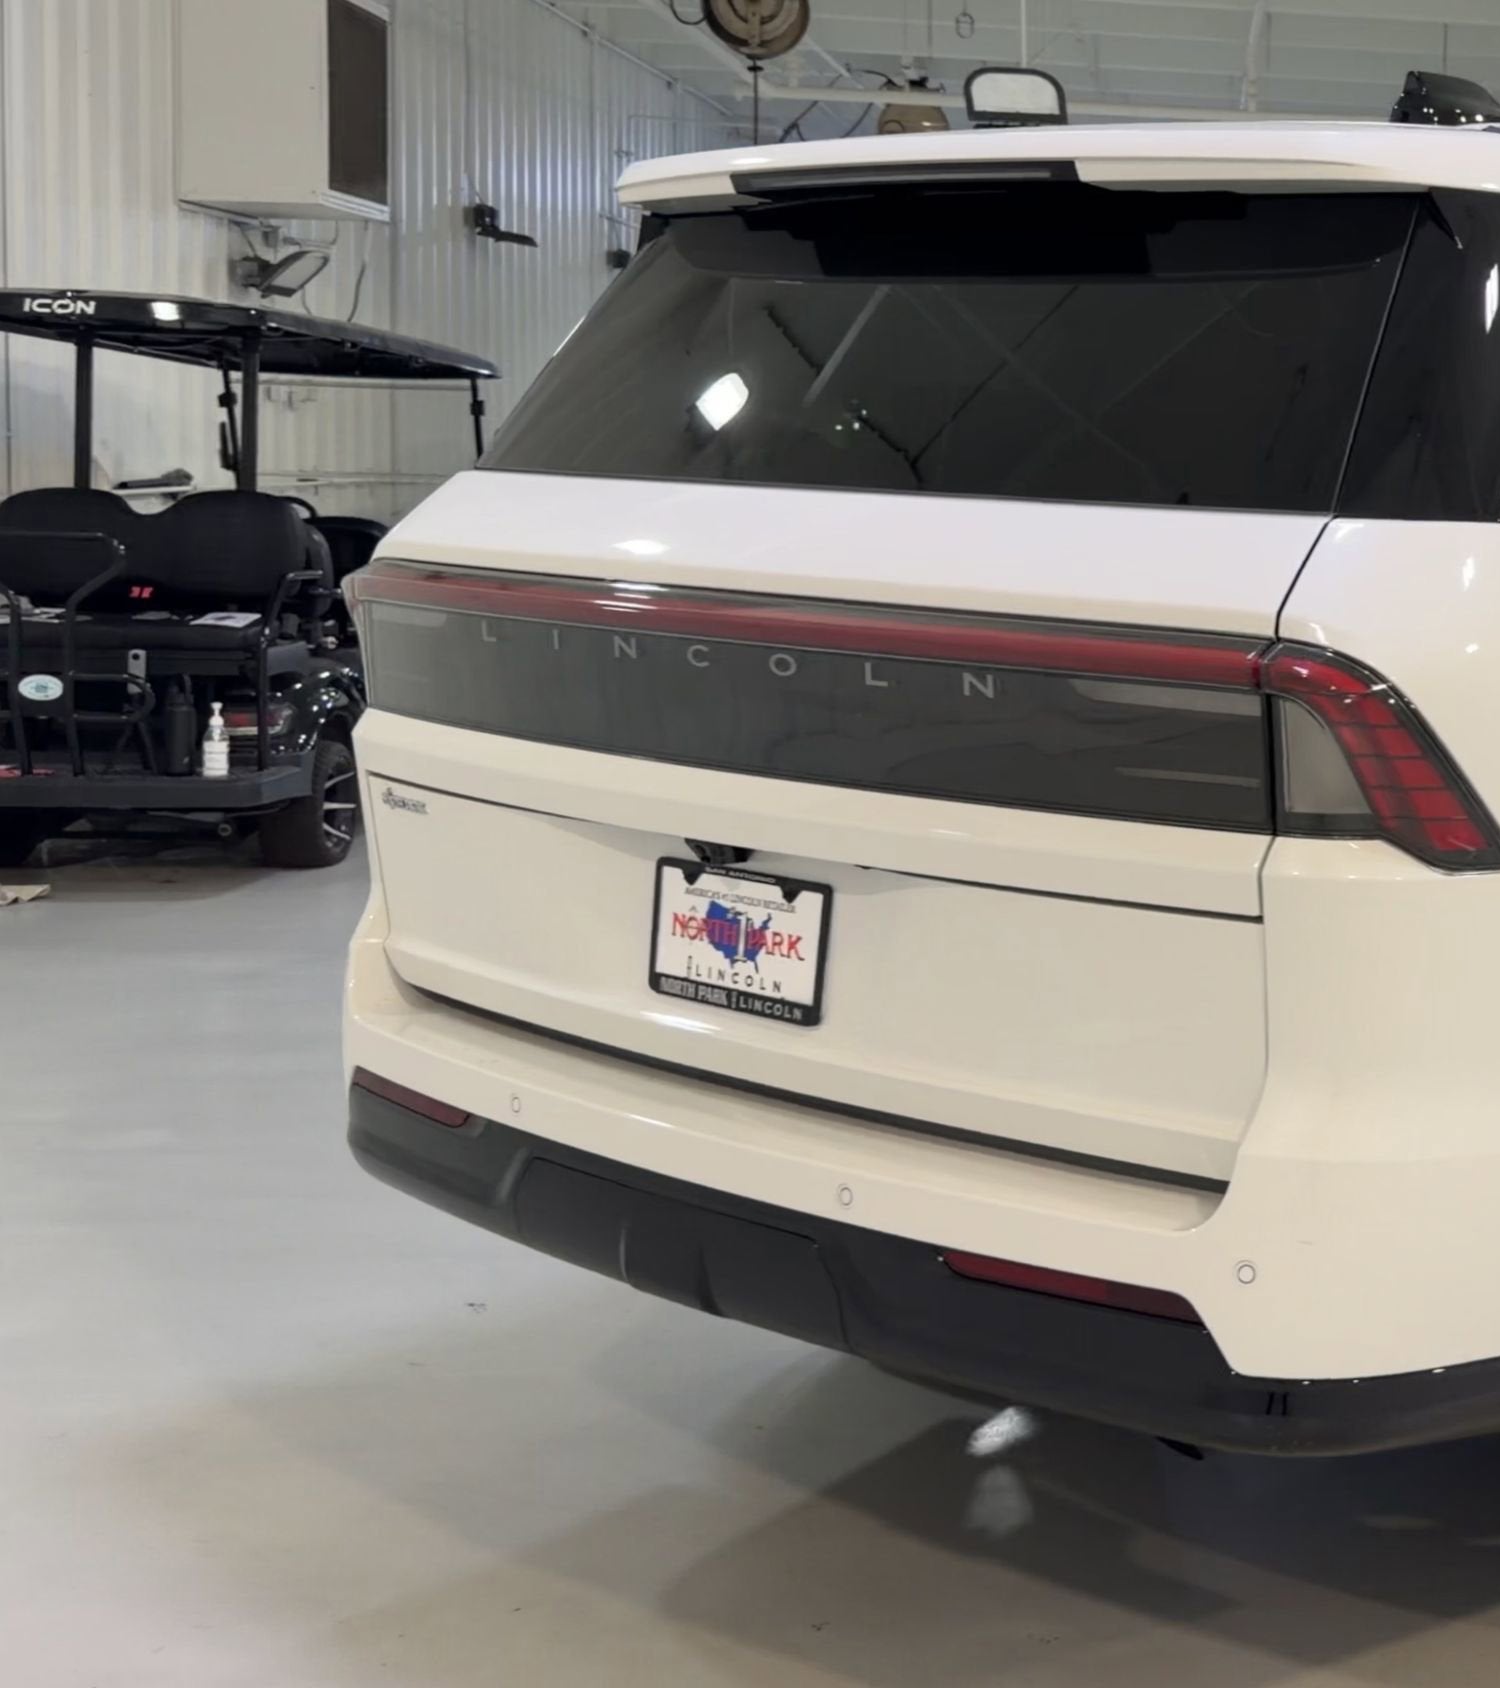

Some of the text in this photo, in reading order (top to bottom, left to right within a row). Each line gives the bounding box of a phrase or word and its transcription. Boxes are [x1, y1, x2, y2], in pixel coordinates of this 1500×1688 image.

[22, 297, 97, 315] ICON
[481, 620, 995, 698] LINCOLN
[671, 911, 806, 962] NORTH PARK
[659, 976, 696, 1000] NORTH
[697, 983, 730, 1007] PARK
[738, 994, 804, 1021] LINCOLN
[695, 963, 783, 994] LINCOLN
